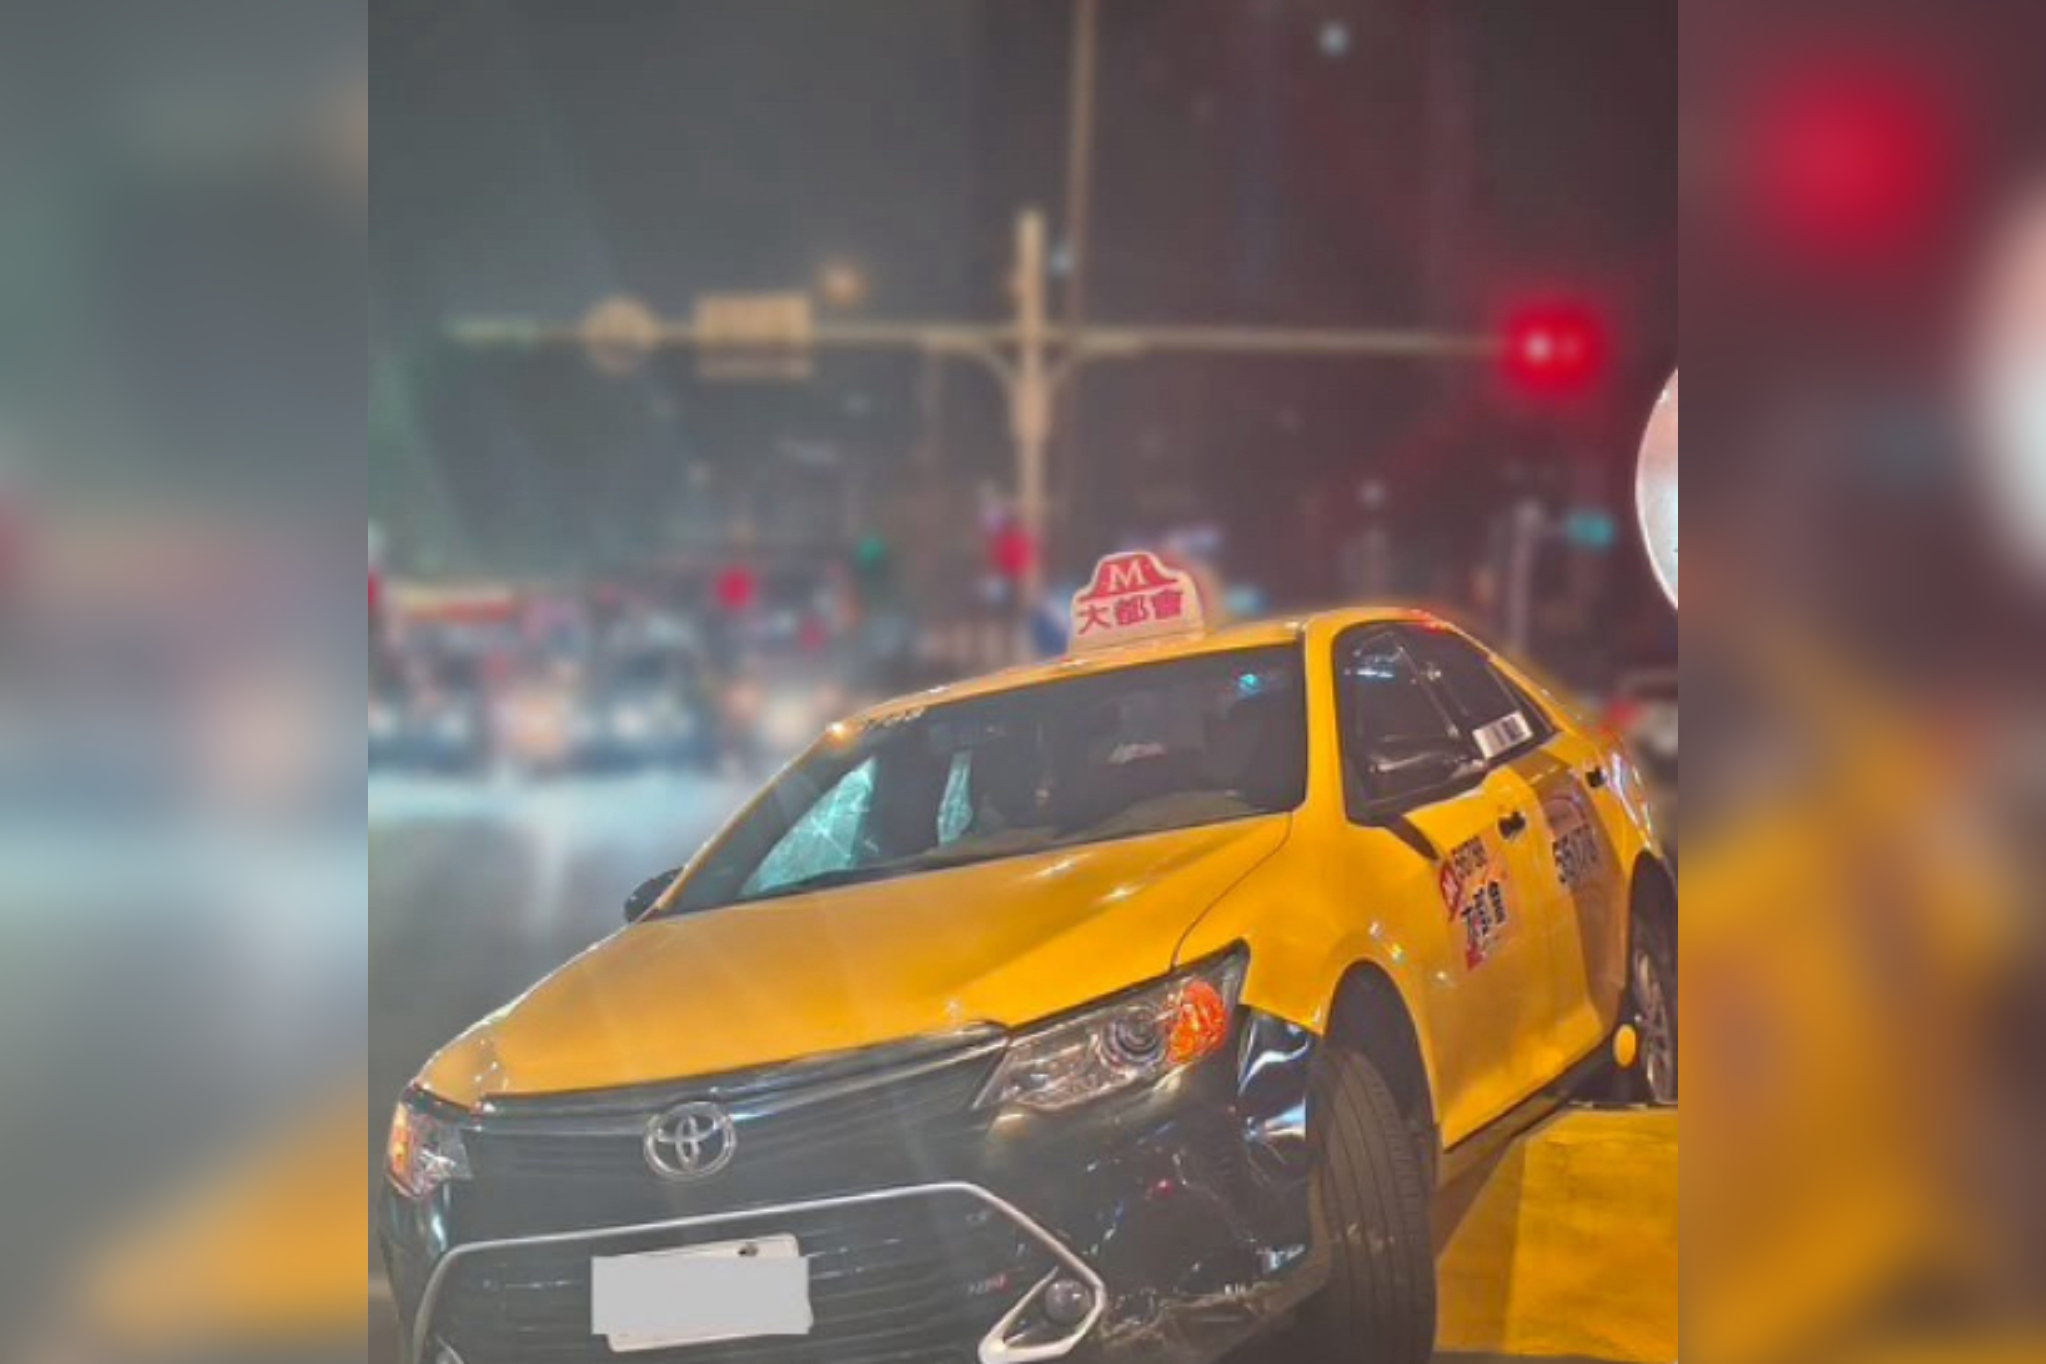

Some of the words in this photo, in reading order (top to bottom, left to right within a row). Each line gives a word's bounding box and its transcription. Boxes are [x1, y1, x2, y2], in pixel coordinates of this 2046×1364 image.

[1105, 560, 1148, 592] M
[1076, 588, 1183, 634] 大都會
